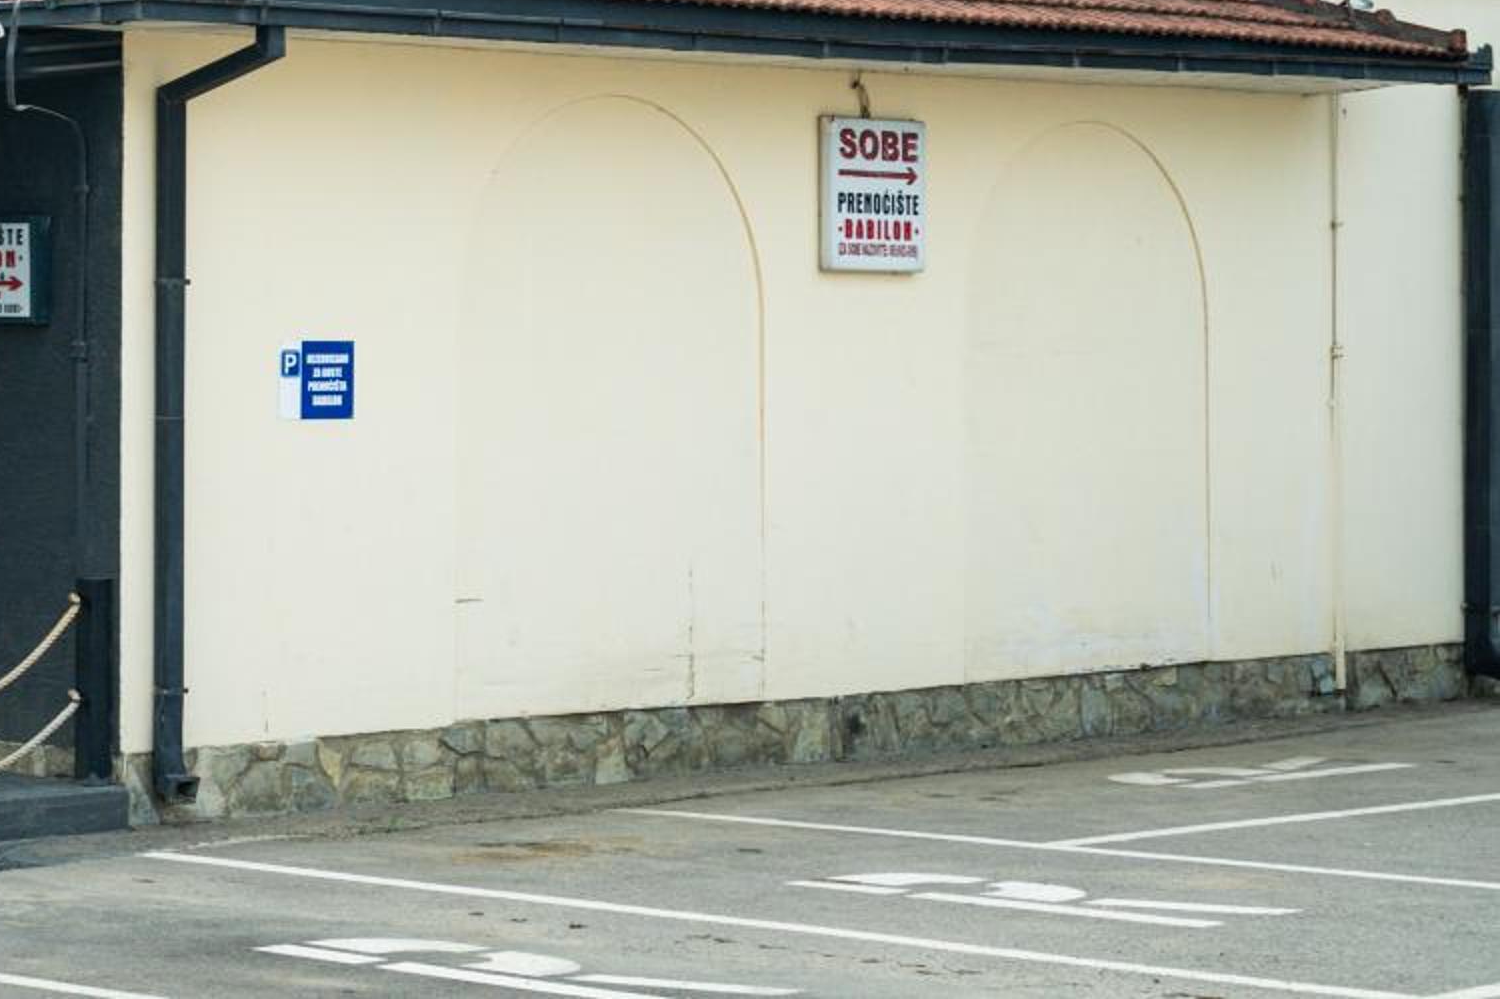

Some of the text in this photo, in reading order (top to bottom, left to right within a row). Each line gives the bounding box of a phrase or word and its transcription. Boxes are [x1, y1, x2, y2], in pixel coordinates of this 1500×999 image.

[839, 128, 919, 162] SOBE
[838, 189, 919, 216] PRENOĆIŠTE
[283, 353, 298, 375] P
